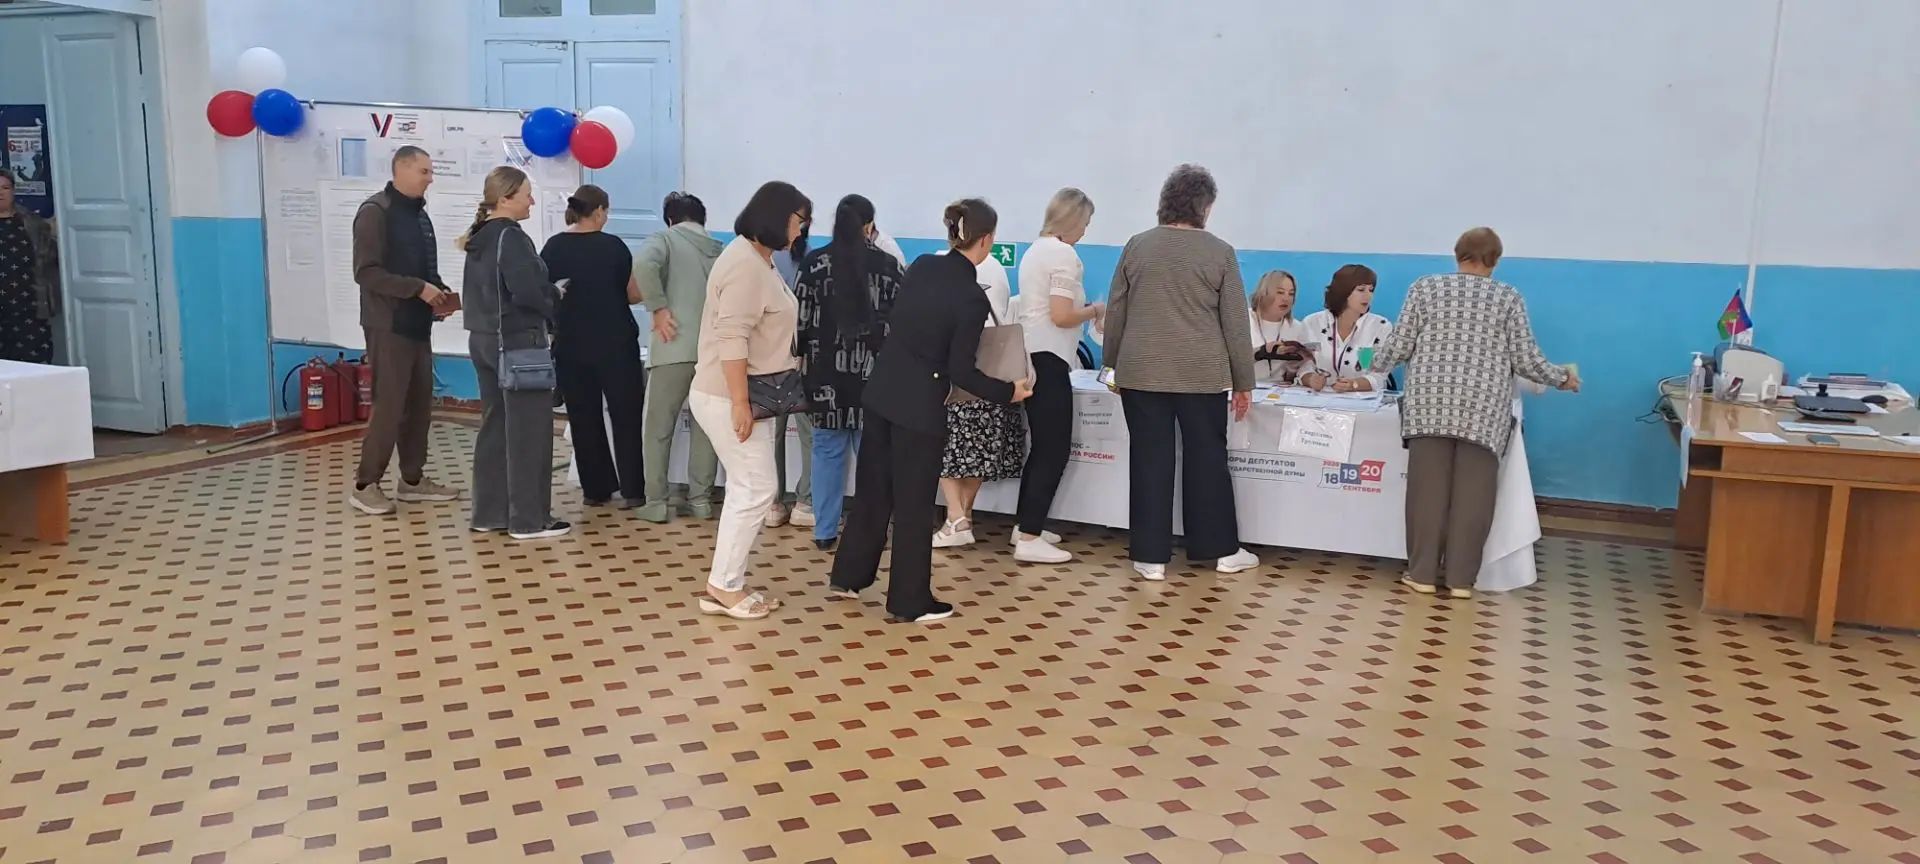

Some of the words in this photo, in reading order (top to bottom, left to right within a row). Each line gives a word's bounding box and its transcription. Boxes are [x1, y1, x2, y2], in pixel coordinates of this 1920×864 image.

[1248, 457, 1296, 467] ДЕПУТАТОВ
[1230, 465, 1283, 475] УДАРСТВЕННОЙ
[1324, 473, 1339, 484] 18
[1342, 468, 1358, 480] 19
[1361, 465, 1381, 477] 20
[1343, 485, 1381, 493] СЕНТЯБРЯ
